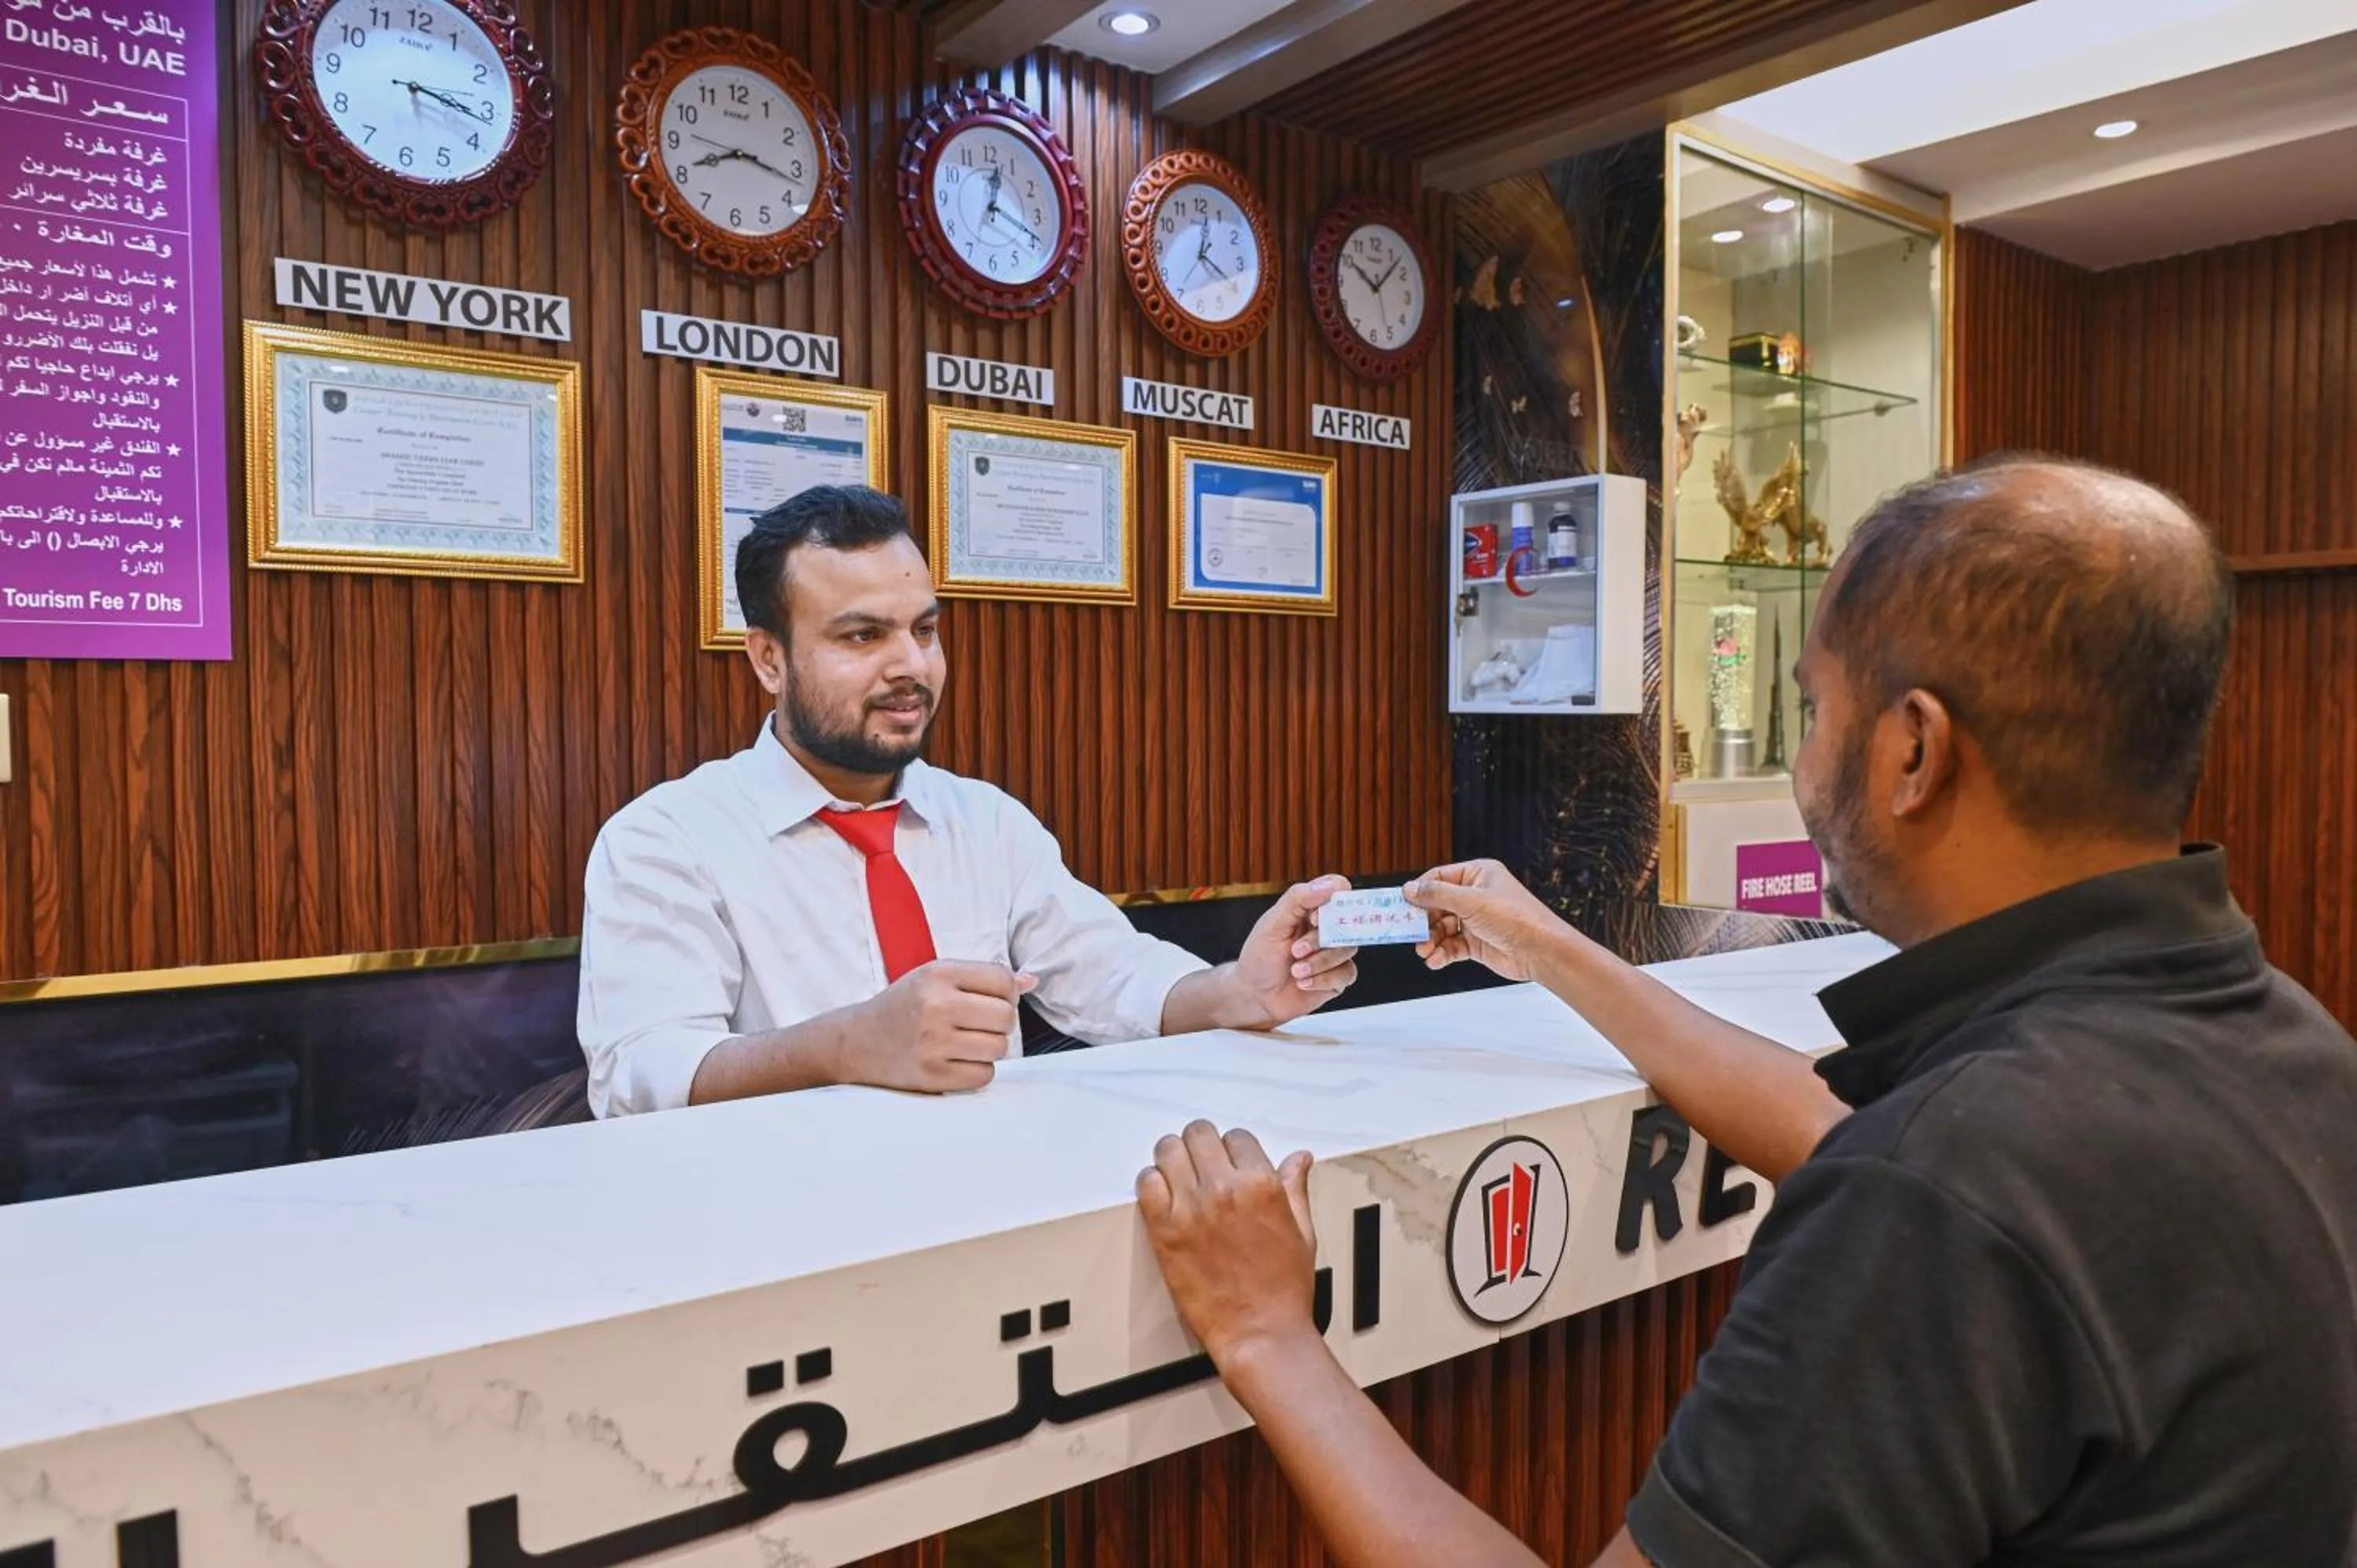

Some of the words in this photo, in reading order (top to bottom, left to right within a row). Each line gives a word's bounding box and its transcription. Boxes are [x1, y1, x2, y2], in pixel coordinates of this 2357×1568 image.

[370, 8, 390, 30] 11
[408, 9, 432, 33] 12
[341, 25, 365, 47] 10
[448, 32, 457, 50] 1
[5, 18, 108, 64] Dubai,
[119, 42, 186, 75] UAE
[327, 53, 340, 73] 9
[473, 64, 487, 83] 2
[0, 76, 68, 105] الغر
[699, 86, 715, 105] 11
[728, 84, 749, 104] 12
[334, 92, 349, 113] 8
[482, 101, 494, 119] 3
[761, 101, 769, 119] 1
[677, 104, 698, 124] 10
[64, 132, 116, 156] مفردة
[362, 125, 376, 145] 7
[466, 133, 479, 150] 4
[668, 130, 680, 149] 9
[783, 127, 794, 146] 2
[123, 140, 167, 167] غرفة
[399, 147, 413, 167] 6
[437, 147, 450, 167] 5
[961, 148, 972, 167] 11
[983, 145, 997, 163] 12
[676, 166, 687, 184] 8
[791, 159, 802, 178] 3
[945, 166, 959, 185] 10
[123, 167, 167, 194] غرفة
[1027, 181, 1036, 198] 2
[699, 192, 712, 211] 7
[782, 190, 792, 207] 4
[939, 190, 948, 207] 9
[1194, 198, 1208, 214] 12
[123, 195, 169, 221] غرفة
[730, 208, 742, 226] 6
[759, 206, 771, 224] 5
[1034, 209, 1041, 225] 3
[1174, 201, 1185, 216] 11
[948, 222, 955, 237] 8
[1160, 218, 1174, 233] 10
[124, 235, 172, 258] وقت
[1230, 230, 1239, 245] 2
[1352, 240, 1362, 253] 11
[1369, 238, 1381, 251] 12
[966, 243, 973, 258] 7
[1155, 240, 1163, 255] 9
[989, 255, 997, 271] 6
[1011, 251, 1019, 267] 5
[1237, 257, 1244, 271] 3
[1342, 255, 1354, 268] 10
[1399, 267, 1406, 281] 2
[291, 264, 416, 317] NEW
[427, 283, 564, 336] YORK
[1177, 289, 1184, 299] 7
[1404, 291, 1410, 304] 3
[1197, 299, 1204, 313] 6
[1354, 318, 1361, 328] 7
[1399, 315, 1406, 325] 4
[1370, 329, 1377, 342] 6
[1387, 327, 1393, 339] 5
[655, 315, 834, 372] LONDON
[937, 356, 1042, 400] DUBAI
[1133, 382, 1248, 424] MUSCAT
[1320, 409, 1405, 445] AFRICA
[2, 588, 84, 609] Tourism
[89, 591, 124, 610] Fee
[129, 593, 141, 610] 7
[145, 592, 183, 613] Dhs
[1742, 878, 1764, 899] FIRE
[1765, 874, 1792, 897] HOSE
[1794, 871, 1817, 893] REEL
